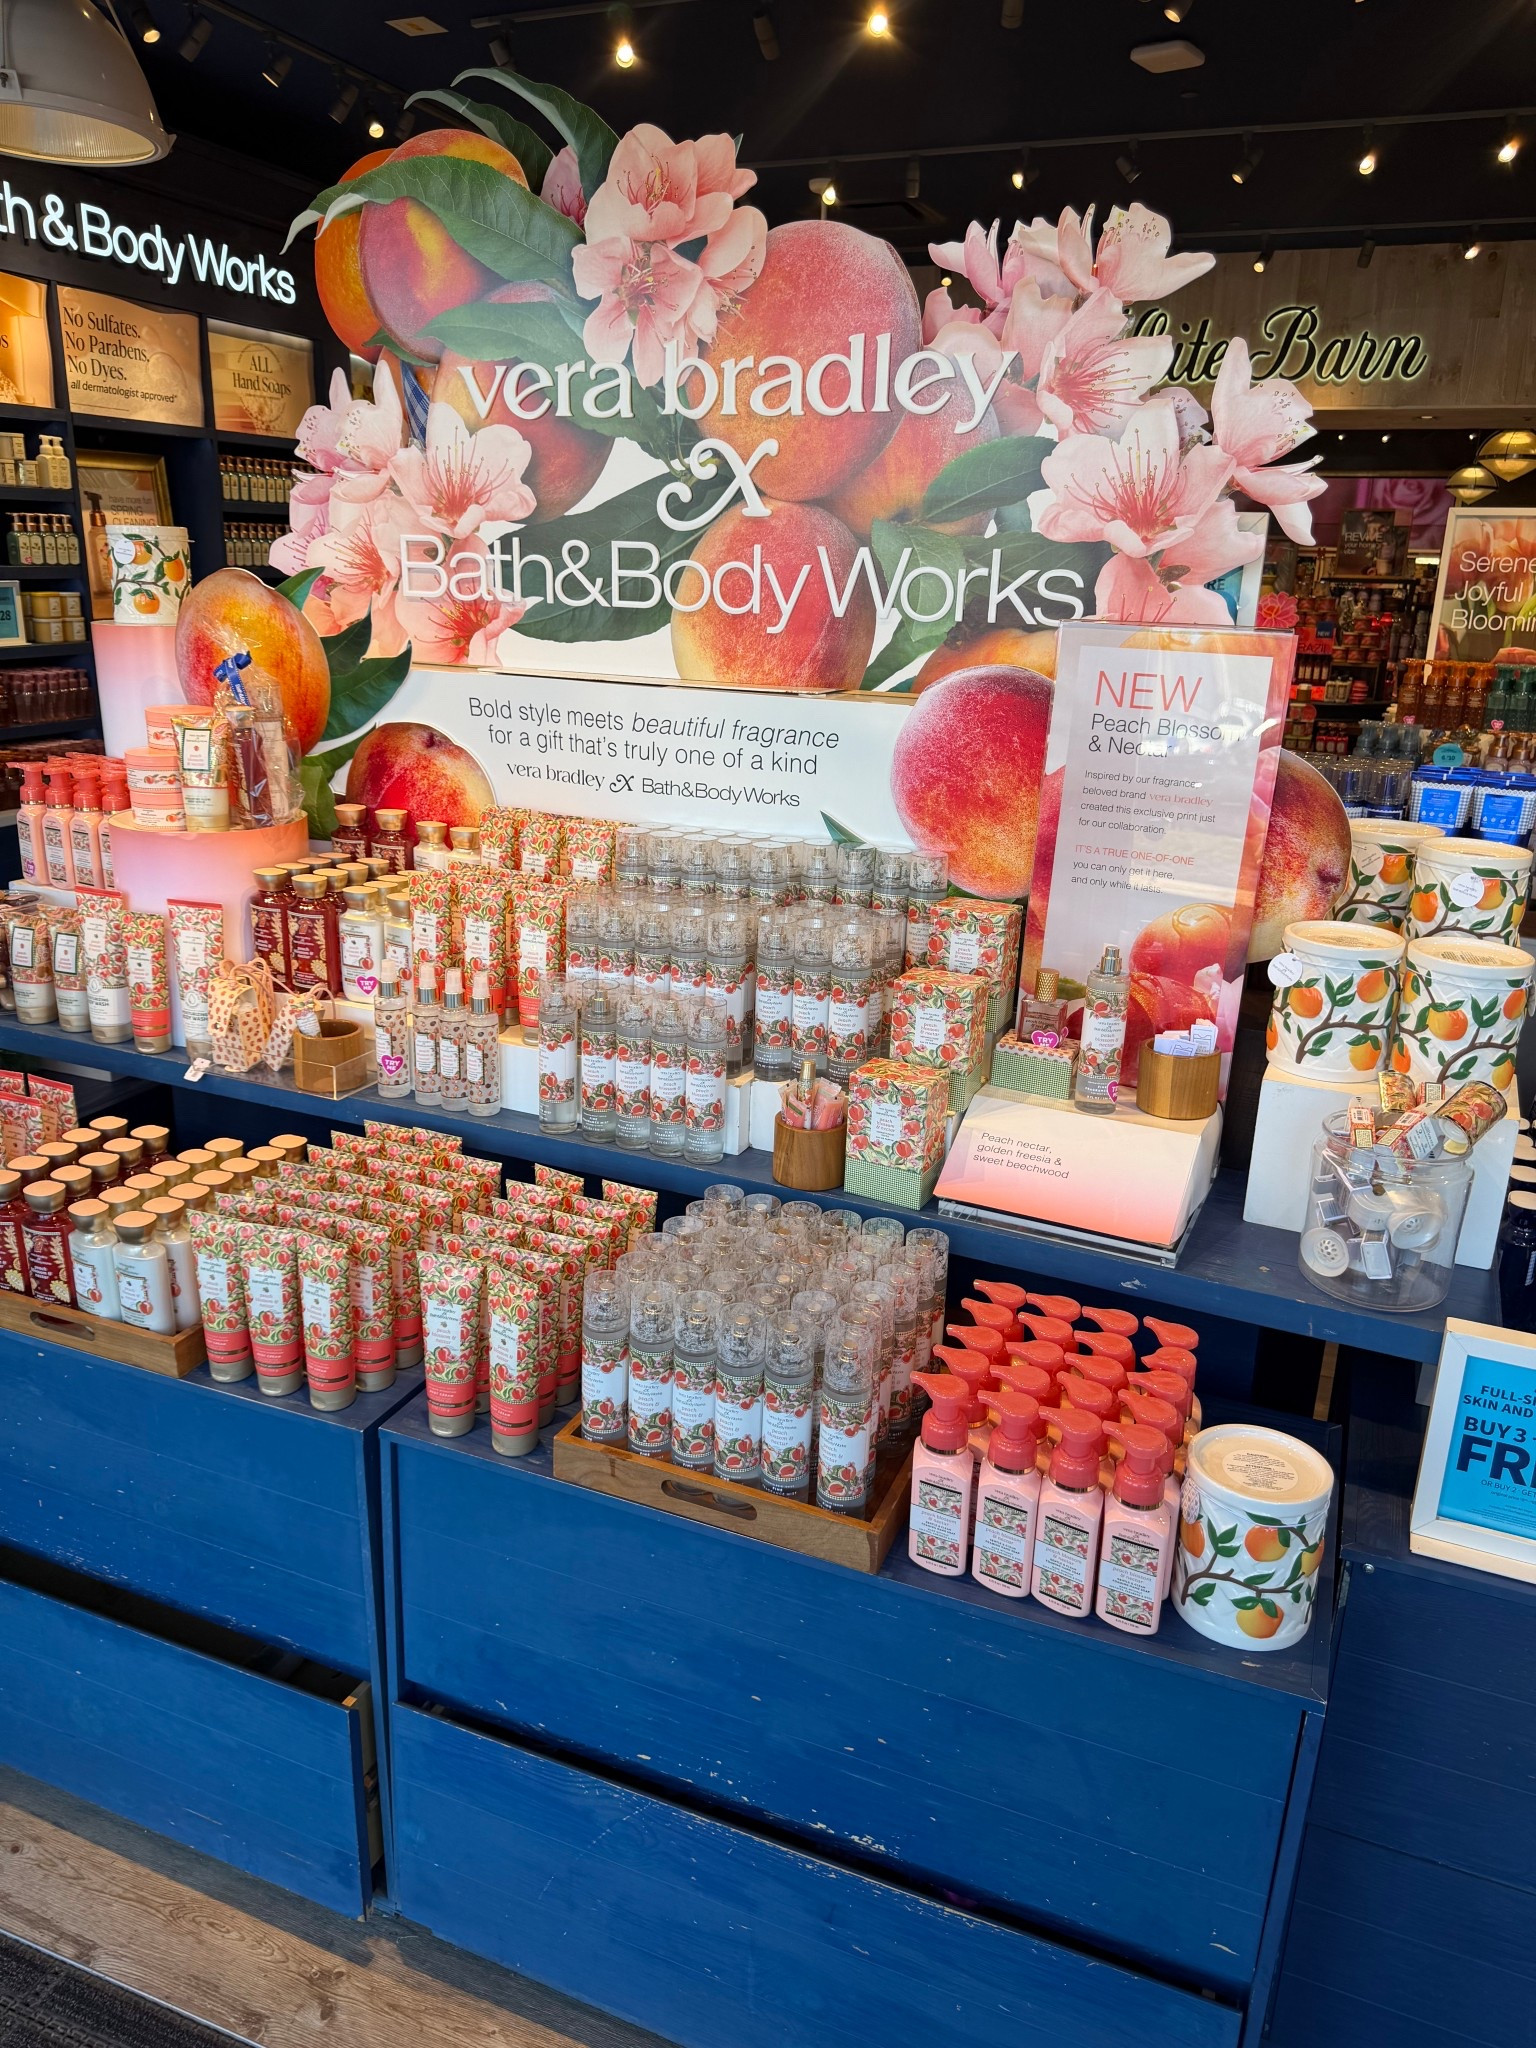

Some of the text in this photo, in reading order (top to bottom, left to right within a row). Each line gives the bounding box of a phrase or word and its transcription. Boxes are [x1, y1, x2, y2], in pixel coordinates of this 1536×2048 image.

[63, 307, 140, 338] No Sulfates.
[65, 330, 150, 362] No Parabens.
[68, 354, 127, 382] No Dyes.
[249, 355, 272, 374] ALL
[70, 380, 80, 390] all
[82, 381, 139, 399] dermatologist
[232, 372, 292, 398] Hand Soaps
[456, 331, 1020, 435] vera bradley
[110, 504, 144, 516] SPRING
[1454, 580, 1524, 606] Joyful
[1094, 670, 1203, 712] NEW
[468, 697, 840, 748] Bold style meets beautiful fragrance
[1091, 713, 1150, 734] Peach
[488, 724, 818, 775] for a gift that's truly one of a kind
[1088, 734, 1102, 753] &
[506, 763, 542, 779] vera
[546, 764, 606, 791] bradley
[1084, 770, 1120, 782] Inspired
[1122, 773, 1134, 784] by
[1136, 776, 1150, 784] our
[1082, 786, 1214, 807] beloved brand vera bradley
[1080, 802, 1216, 824] created this exclusive print just
[1078, 817, 1167, 834] for our collaboration.
[1075, 844, 1195, 866] IT'S A TRUE ONE-OF-ONE
[1072, 861, 1175, 880] you can only get it here.
[1070, 876, 1088, 884] and
[1090, 878, 1108, 888] only
[1110, 881, 1132, 890] while
[1140, 883, 1163, 894] lasts.
[1037, 1036, 1054, 1044] TRY
[982, 1132, 1052, 1154] Peach nectar,
[973, 1154, 1070, 1178] sweet beechwood
[976, 1144, 1062, 1166] golden freesia &
[1463, 1394, 1534, 1418] SKIN AND
[1464, 1416, 1527, 1443] BUY 3
[1494, 1482, 1510, 1492] BUY
